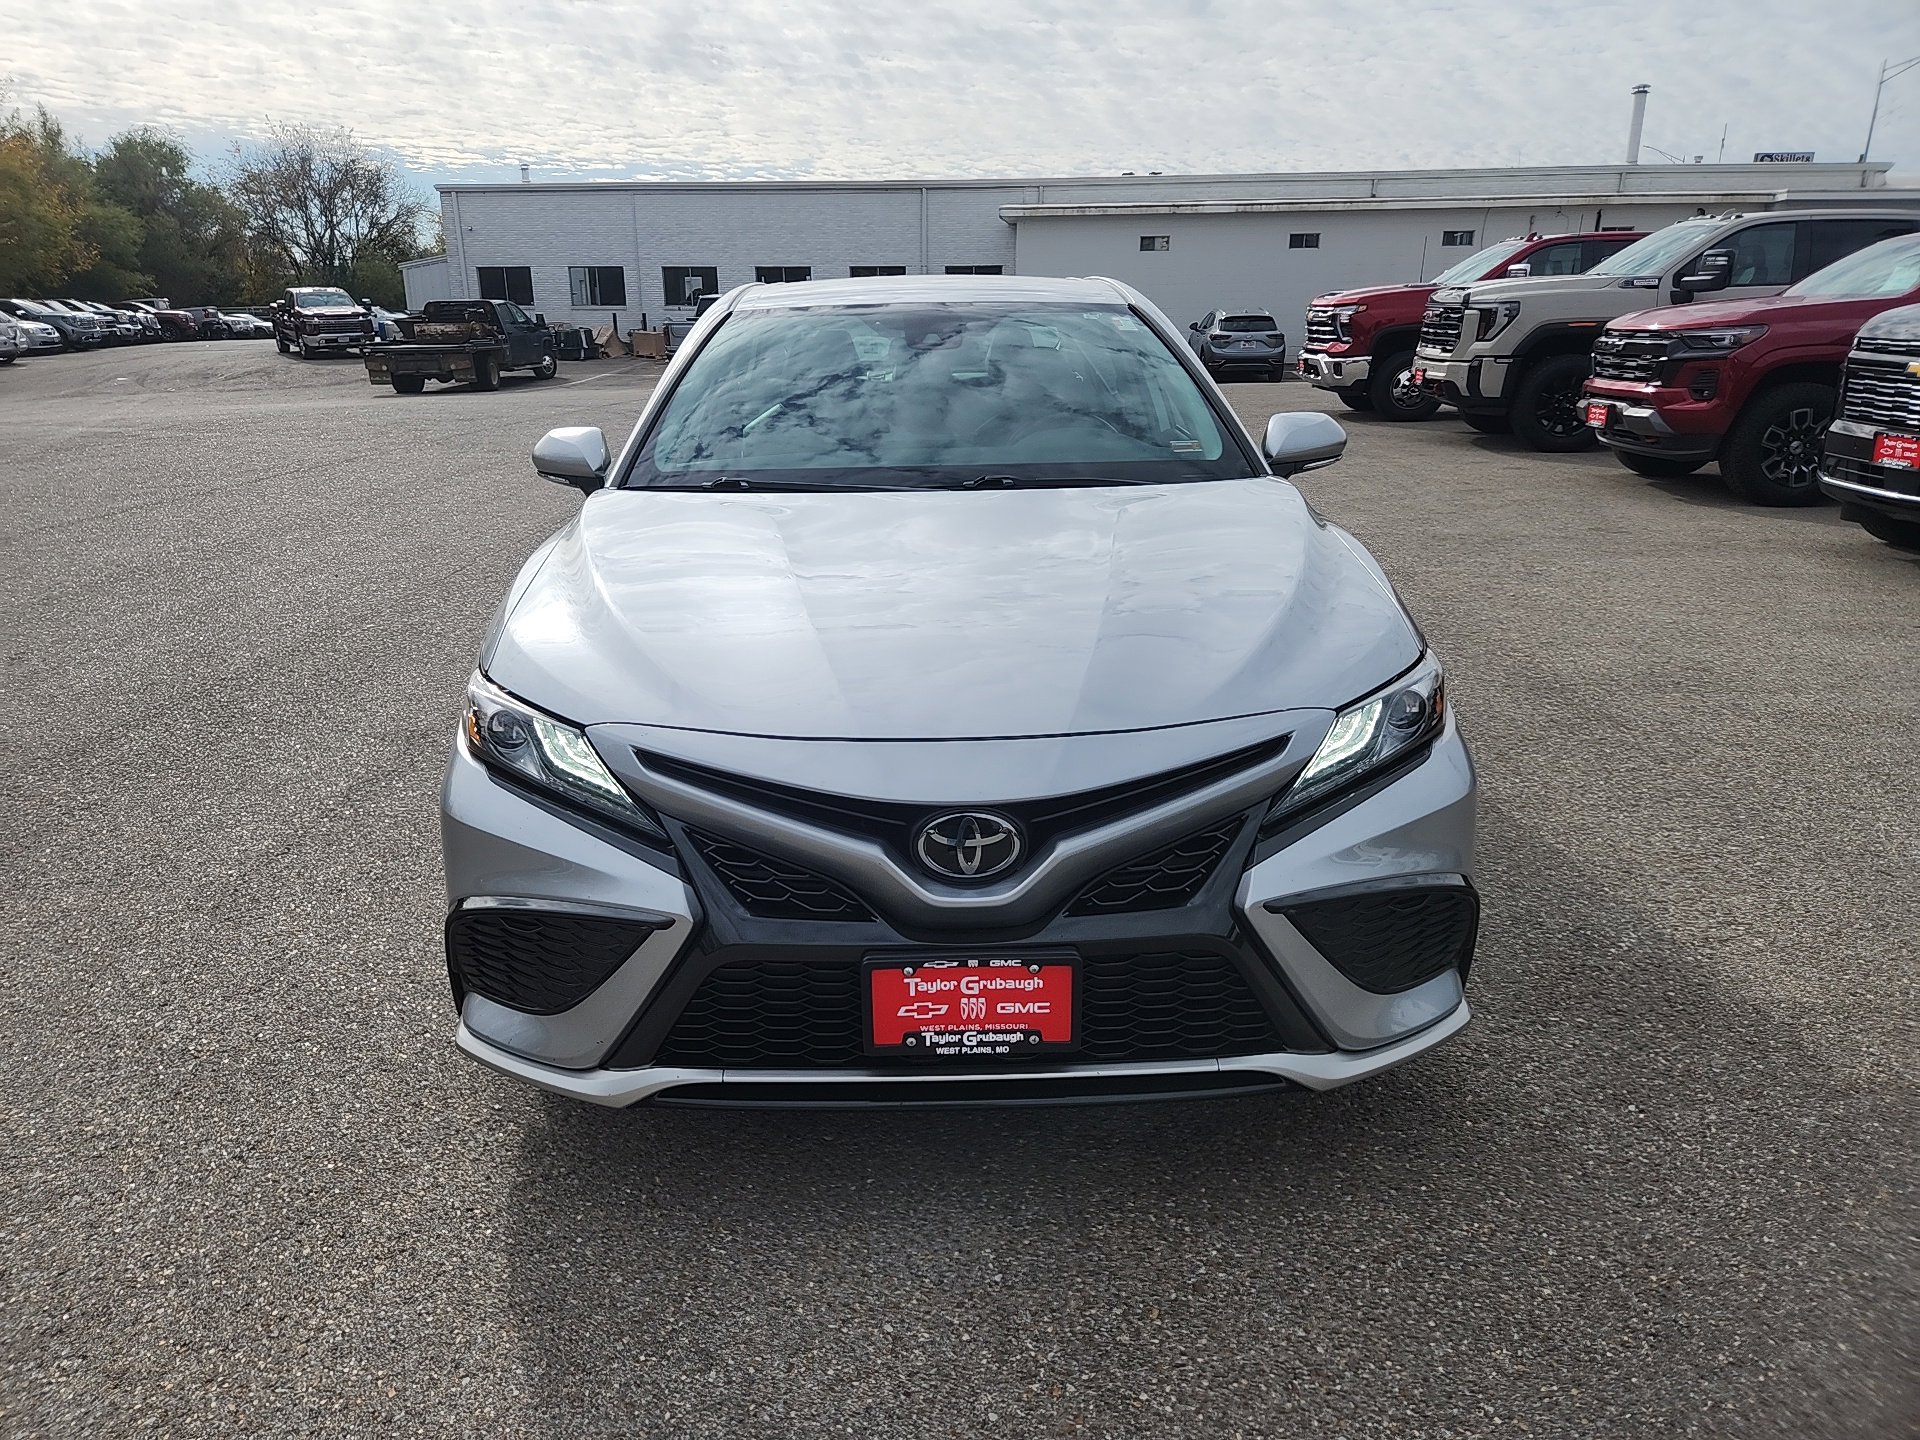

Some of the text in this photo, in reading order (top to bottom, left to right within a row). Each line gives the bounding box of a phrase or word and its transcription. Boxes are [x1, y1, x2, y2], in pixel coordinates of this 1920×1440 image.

[989, 959, 1022, 967] GMC
[903, 975, 1044, 997] Taylor Grubaugh
[996, 1002, 1051, 1014] GMC
[920, 1024, 946, 1032] WEST
[920, 1031, 1025, 1047] Taylor Grubaugh
[935, 1045, 1010, 1055] WEST PLAINS, MO
